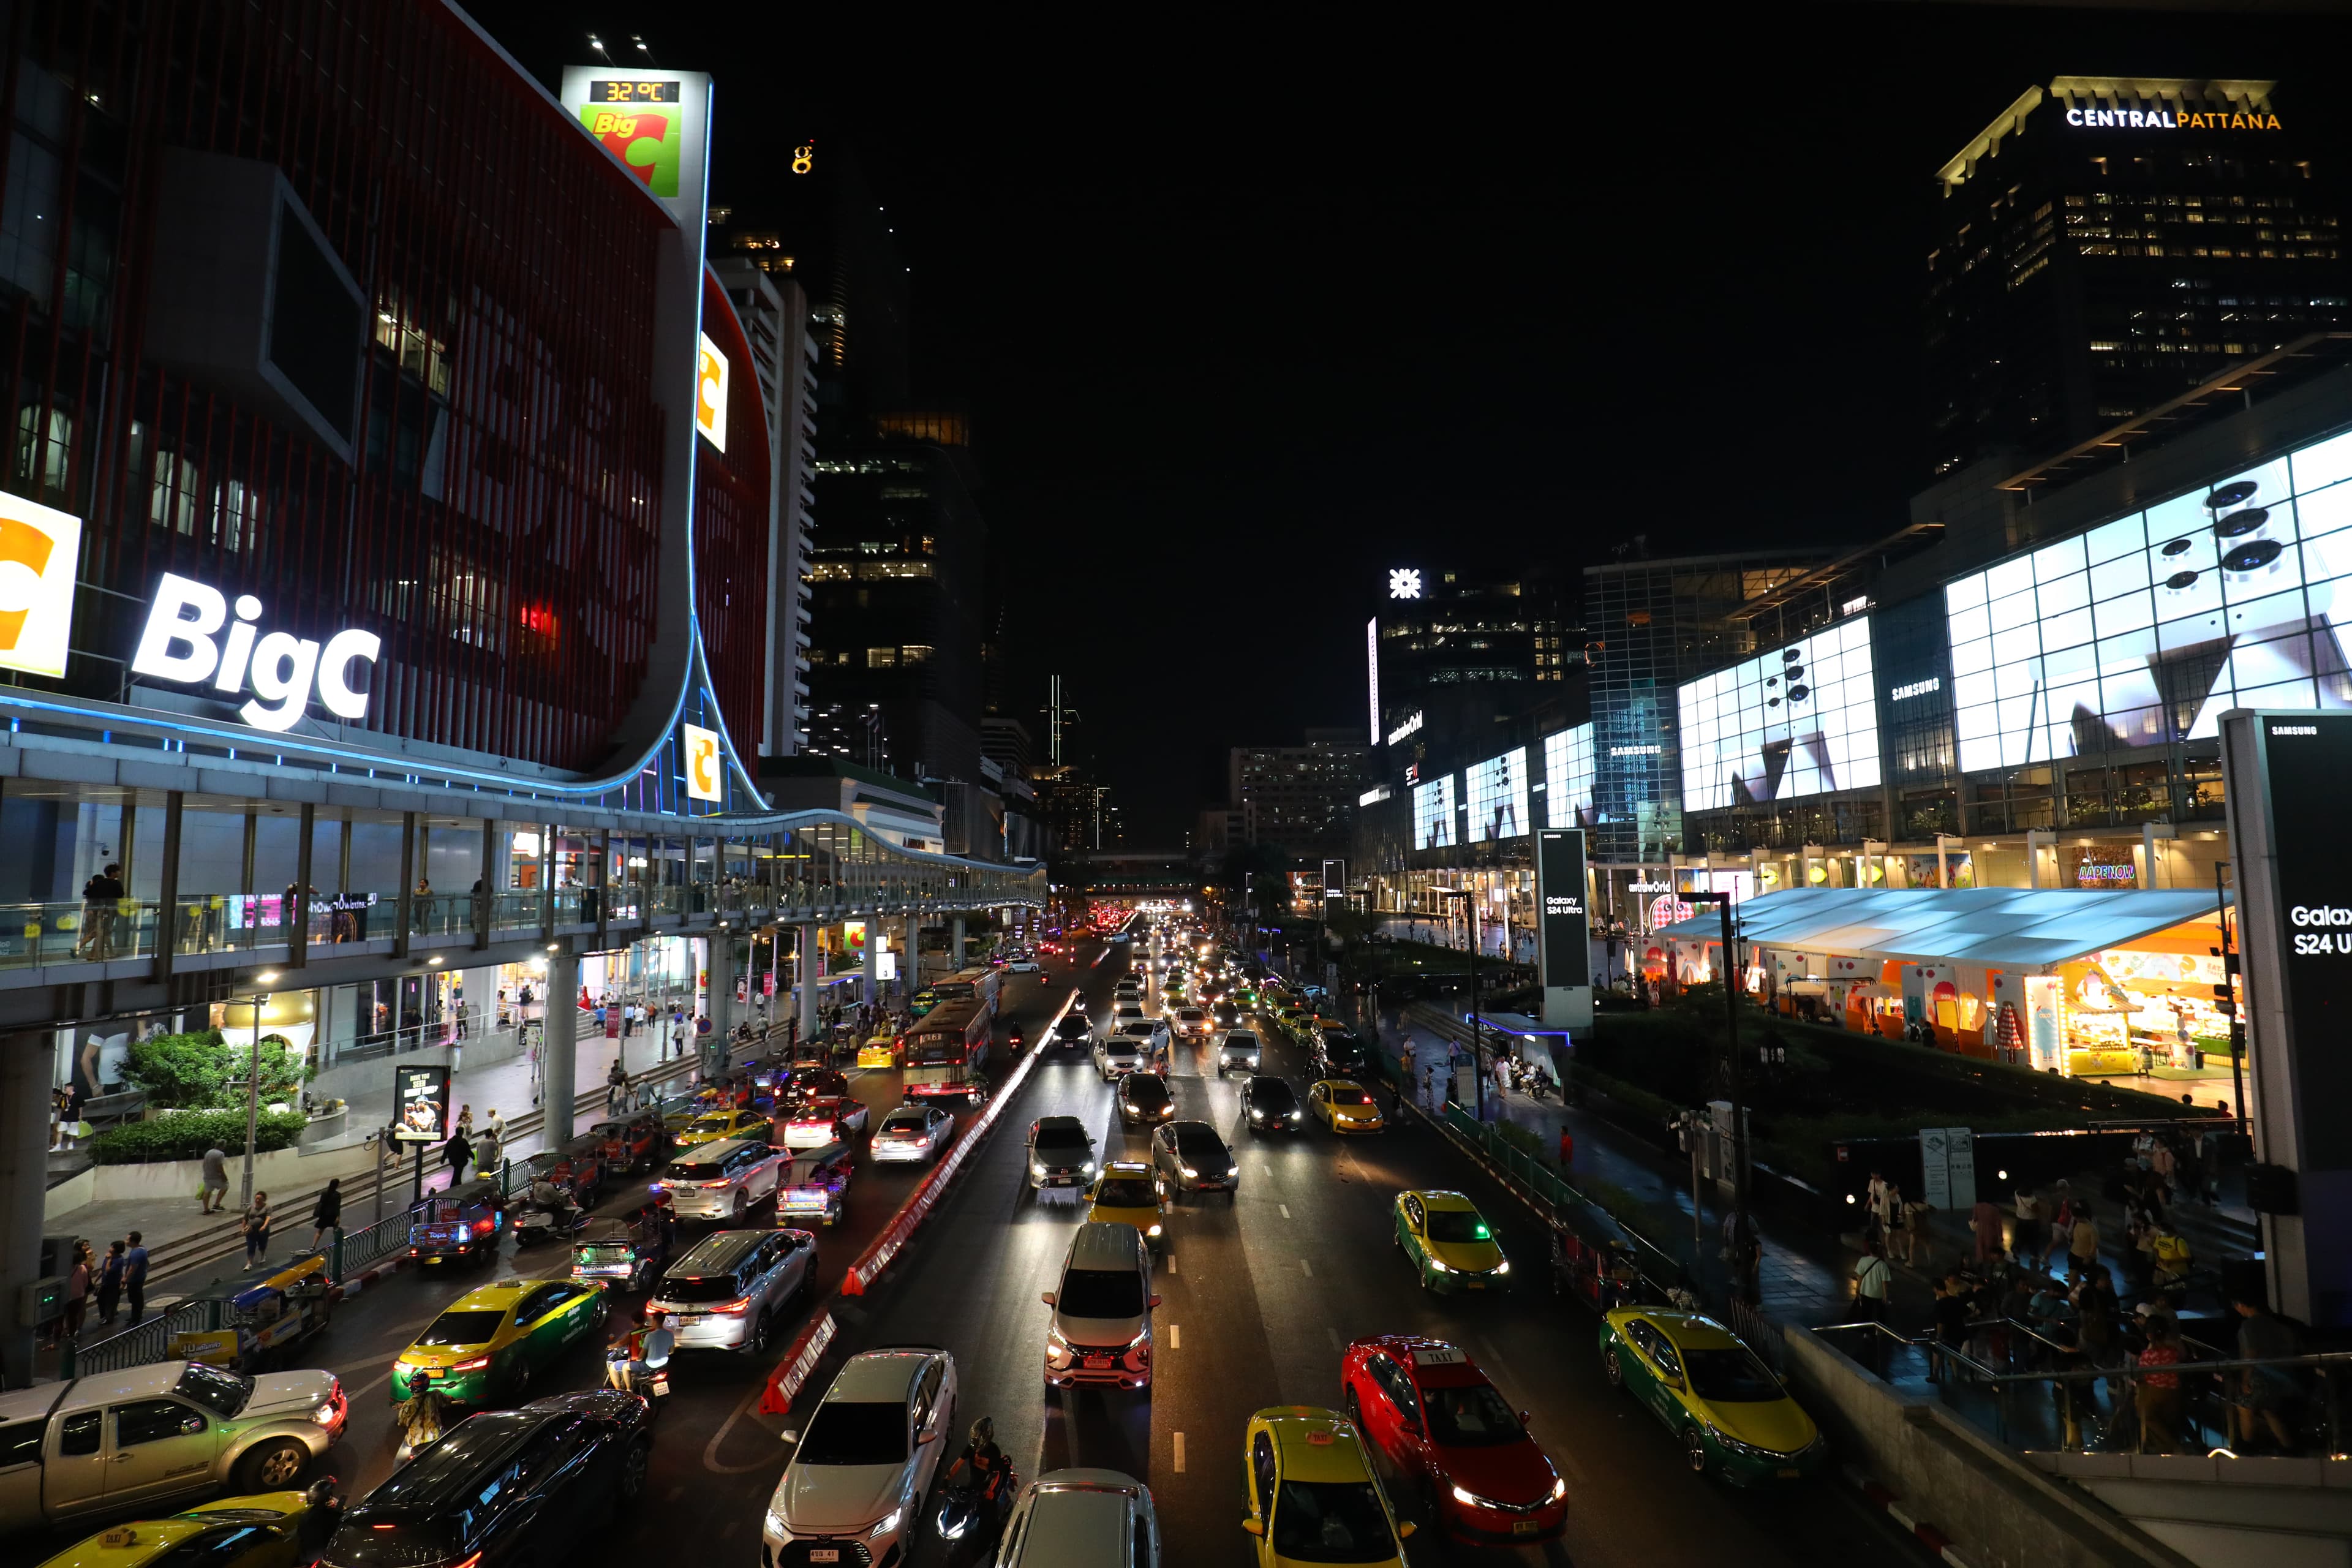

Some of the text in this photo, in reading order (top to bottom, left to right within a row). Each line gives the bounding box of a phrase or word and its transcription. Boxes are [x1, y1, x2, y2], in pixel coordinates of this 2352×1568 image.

[607, 82, 632, 102] 32
[592, 113, 638, 138] Big
[2067, 108, 2282, 130] CENTRAL PATTANA
[792, 146, 812, 174] g
[131, 571, 381, 731] BigC
[1892, 677, 1940, 701] SAMSUNG
[2272, 726, 2318, 736] SAMSUNG
[1611, 745, 1662, 756] SAMSUNG
[1546, 896, 1577, 907] Galaxy
[1562, 906, 1583, 914] Ultra
[2294, 933, 2352, 955] S24 U
[1428, 1352, 1453, 1363] TAXI
[105, 1534, 122, 1544] TAXI
